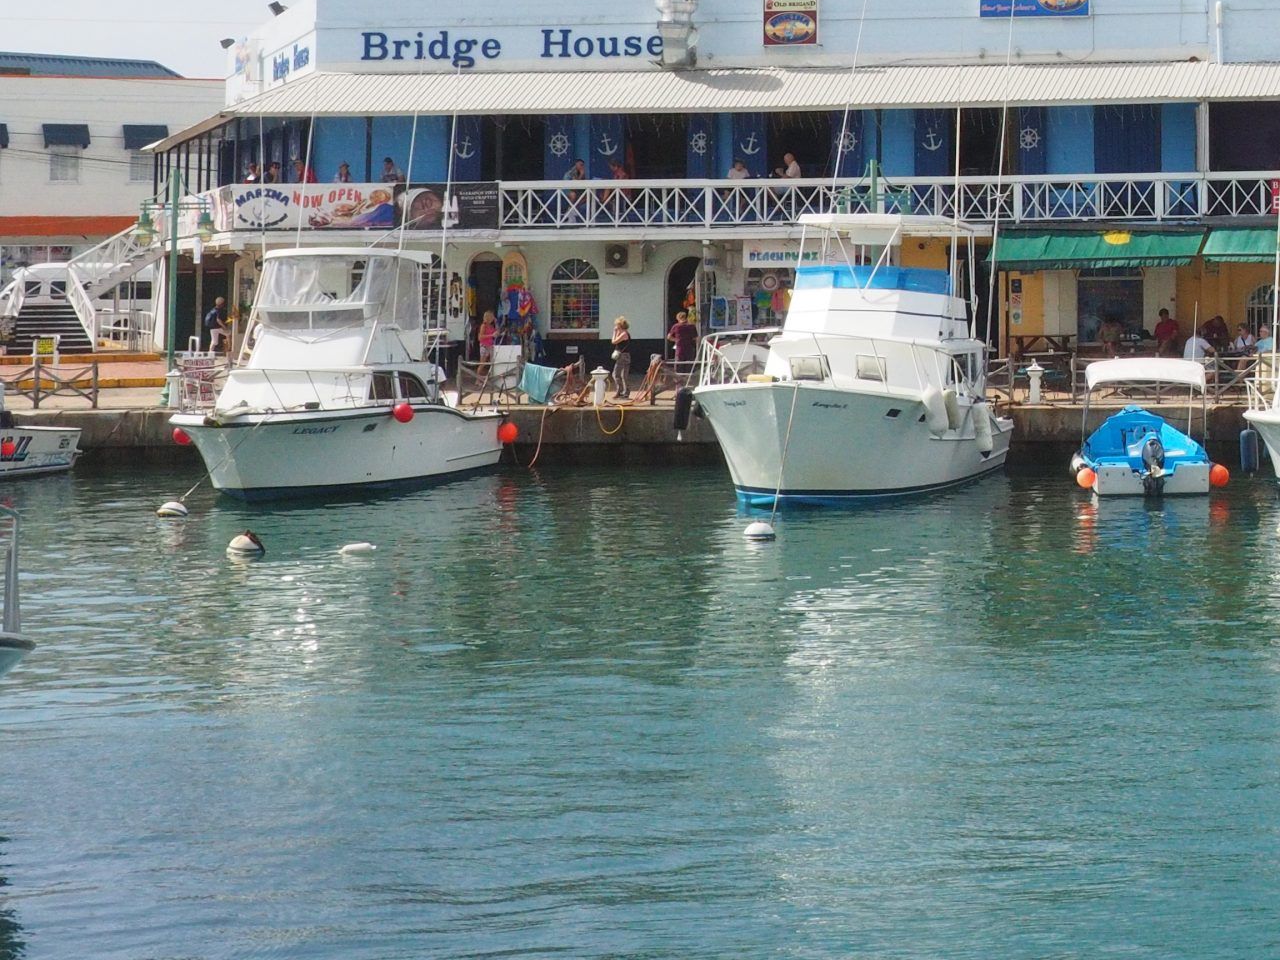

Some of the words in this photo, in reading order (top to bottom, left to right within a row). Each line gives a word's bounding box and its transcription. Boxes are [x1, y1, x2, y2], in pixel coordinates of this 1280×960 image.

[361, 31, 501, 68] Bridge
[540, 29, 664, 57] House
[235, 188, 289, 207] MARINA
[292, 191, 323, 208] NOW
[329, 189, 362, 203] OPEN
[293, 425, 341, 435] LEGACY
